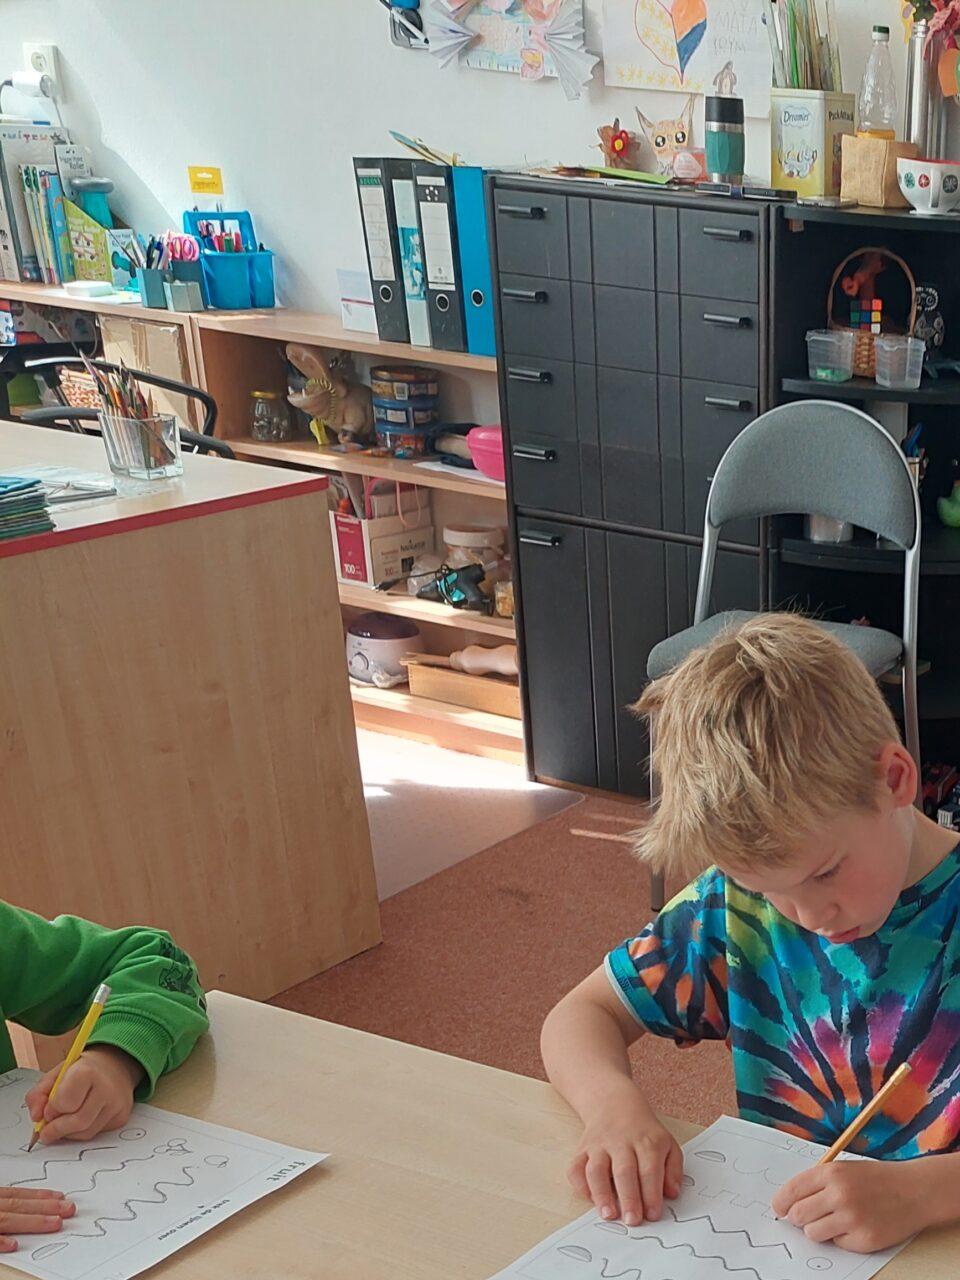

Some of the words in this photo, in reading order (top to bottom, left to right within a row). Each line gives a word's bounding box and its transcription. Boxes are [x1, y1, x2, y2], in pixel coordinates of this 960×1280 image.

[266, 1161, 306, 1182] fruit
[213, 1200, 230, 1209] trek
[201, 1208, 212, 1216] de
[177, 1215, 202, 1229] lijnen
[158, 1228, 177, 1241] over
